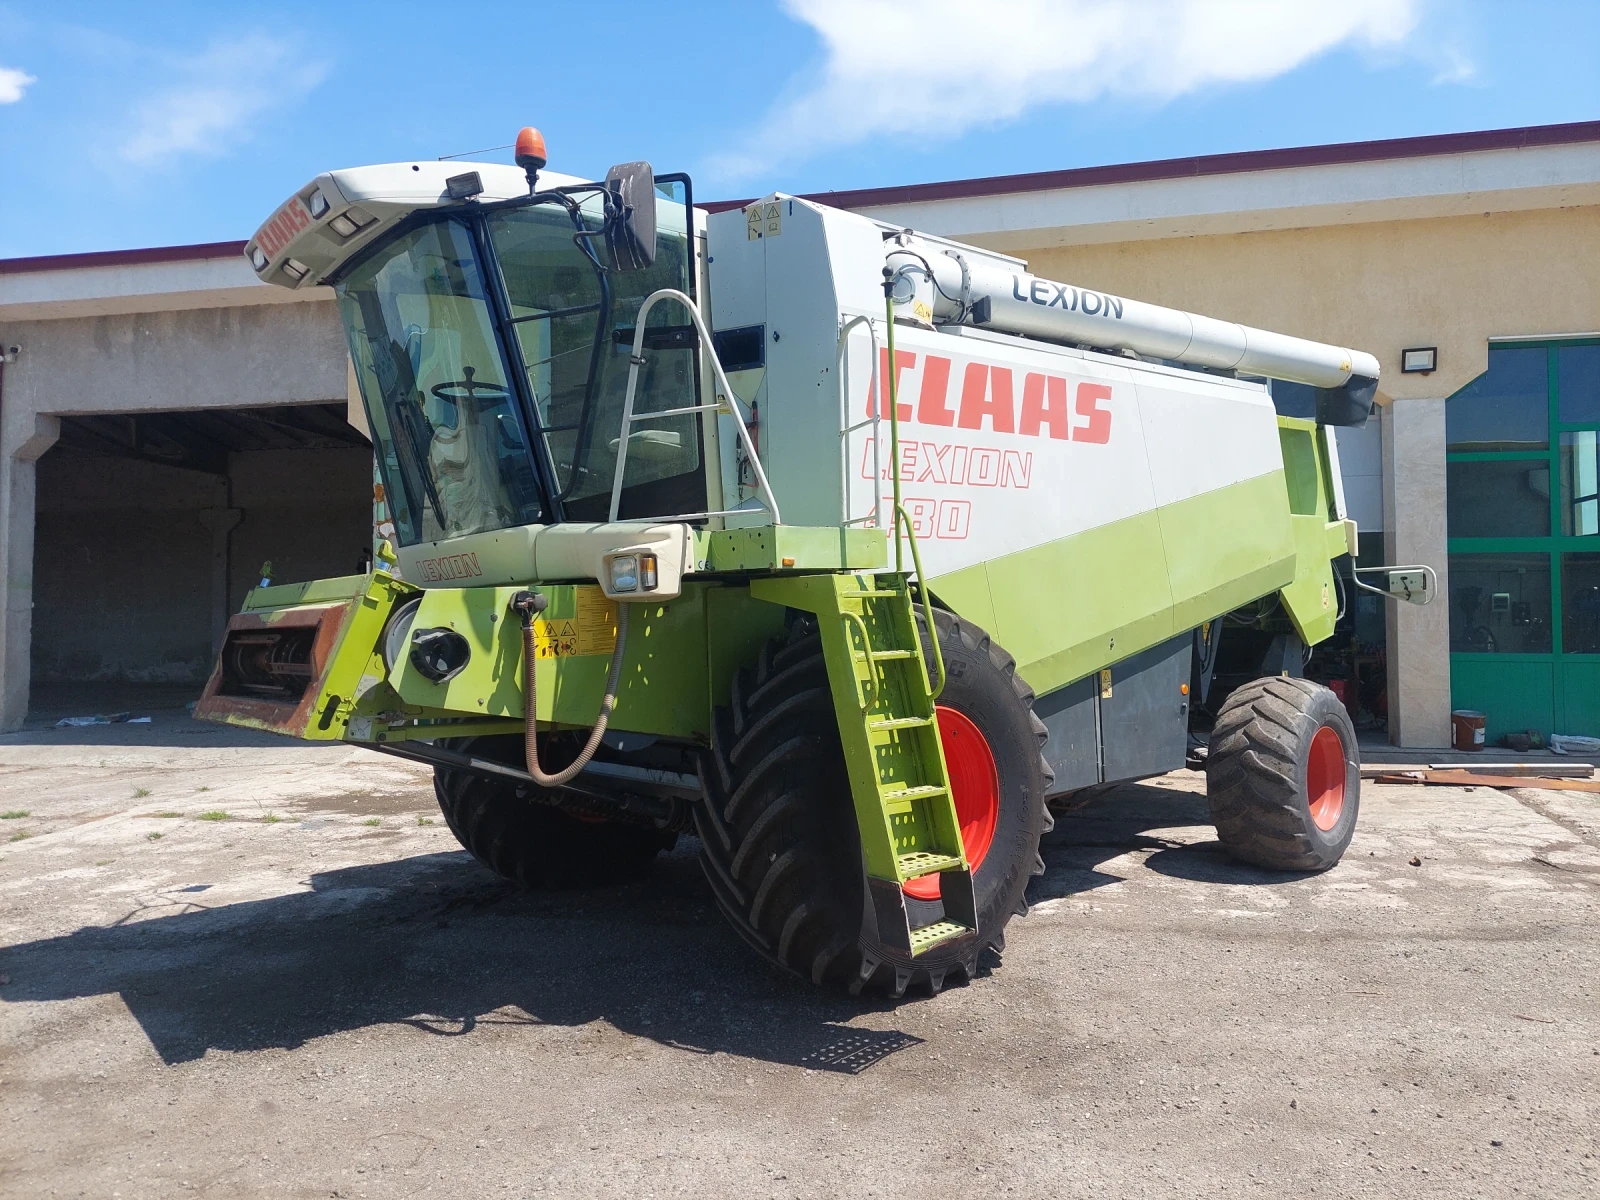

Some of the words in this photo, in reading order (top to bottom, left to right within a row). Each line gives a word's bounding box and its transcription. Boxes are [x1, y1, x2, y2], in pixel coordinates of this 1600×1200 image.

[256, 198, 310, 259] CLAAS
[1012, 274, 1124, 320] LEXION
[865, 346, 1113, 445] CLAAS
[861, 437, 1033, 489] LEXION
[415, 552, 482, 582] LEXION
